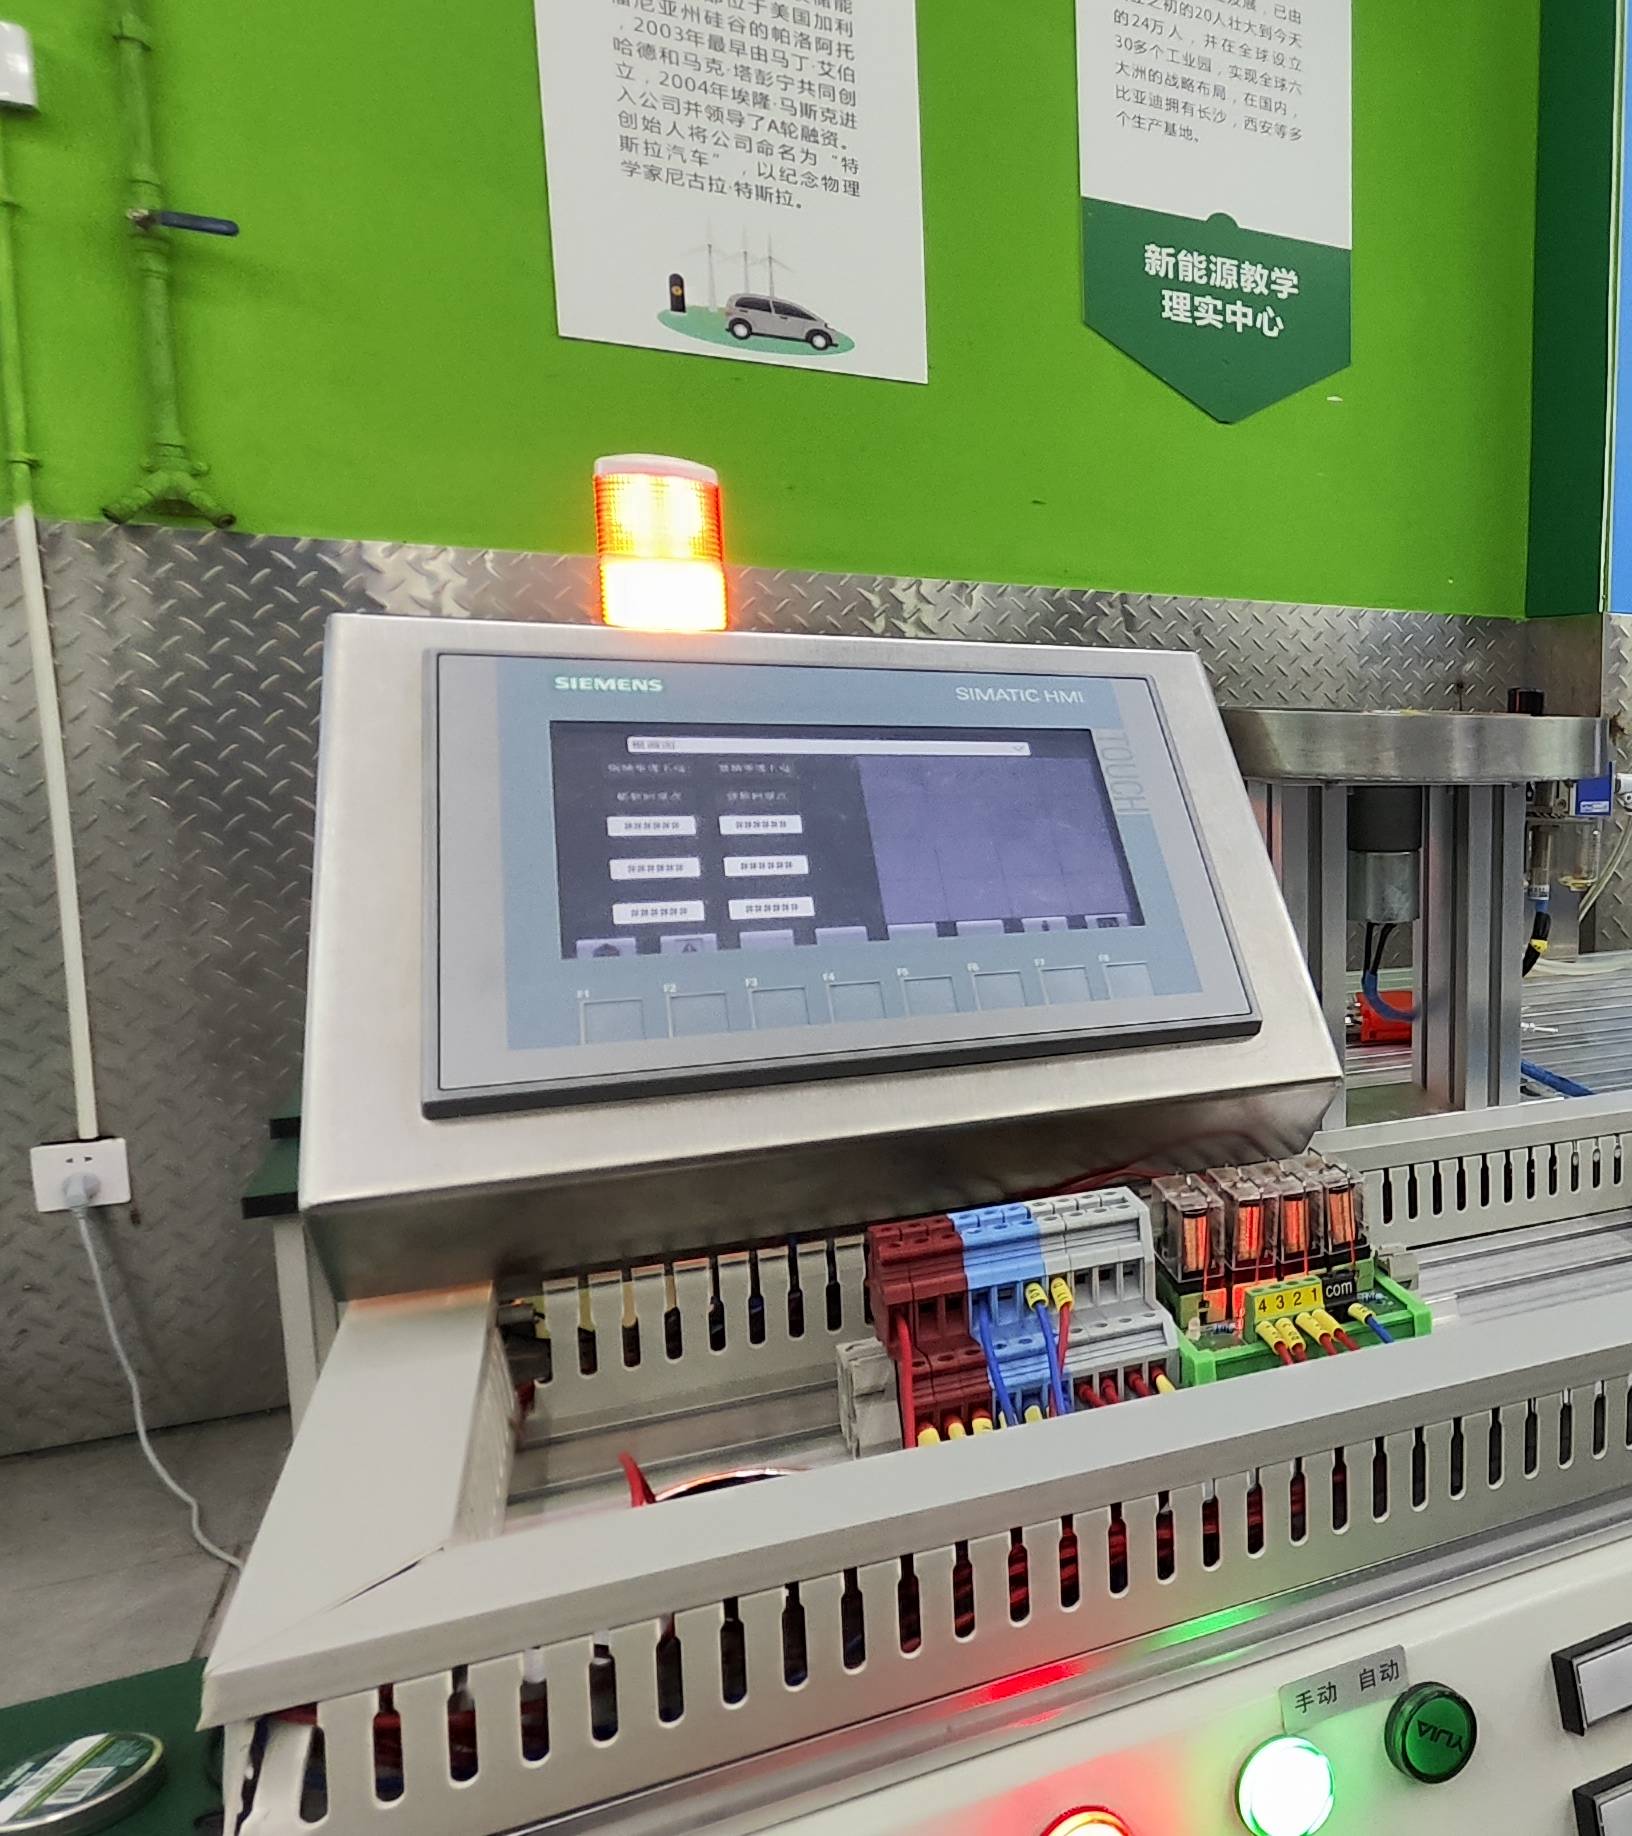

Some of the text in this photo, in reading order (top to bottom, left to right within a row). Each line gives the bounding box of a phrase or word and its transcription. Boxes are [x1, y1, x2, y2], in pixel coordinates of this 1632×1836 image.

[1131, 0, 1302, 48] 之初的20人壮大到今天
[1145, 243, 1299, 299] 新能源教学
[1161, 289, 1285, 338] 理实中心
[555, 676, 664, 692] SIEMENS
[955, 686, 1084, 704] SIMATIC HMI
[1096, 731, 1150, 814] TOUCH
[1258, 1298, 1267, 1312] 4
[1275, 1295, 1285, 1309] 3
[1293, 1291, 1302, 1306] 2
[1311, 1287, 1318, 1302] 1
[1325, 1281, 1353, 1298] com
[1294, 1658, 1400, 1714] 手动 自动
